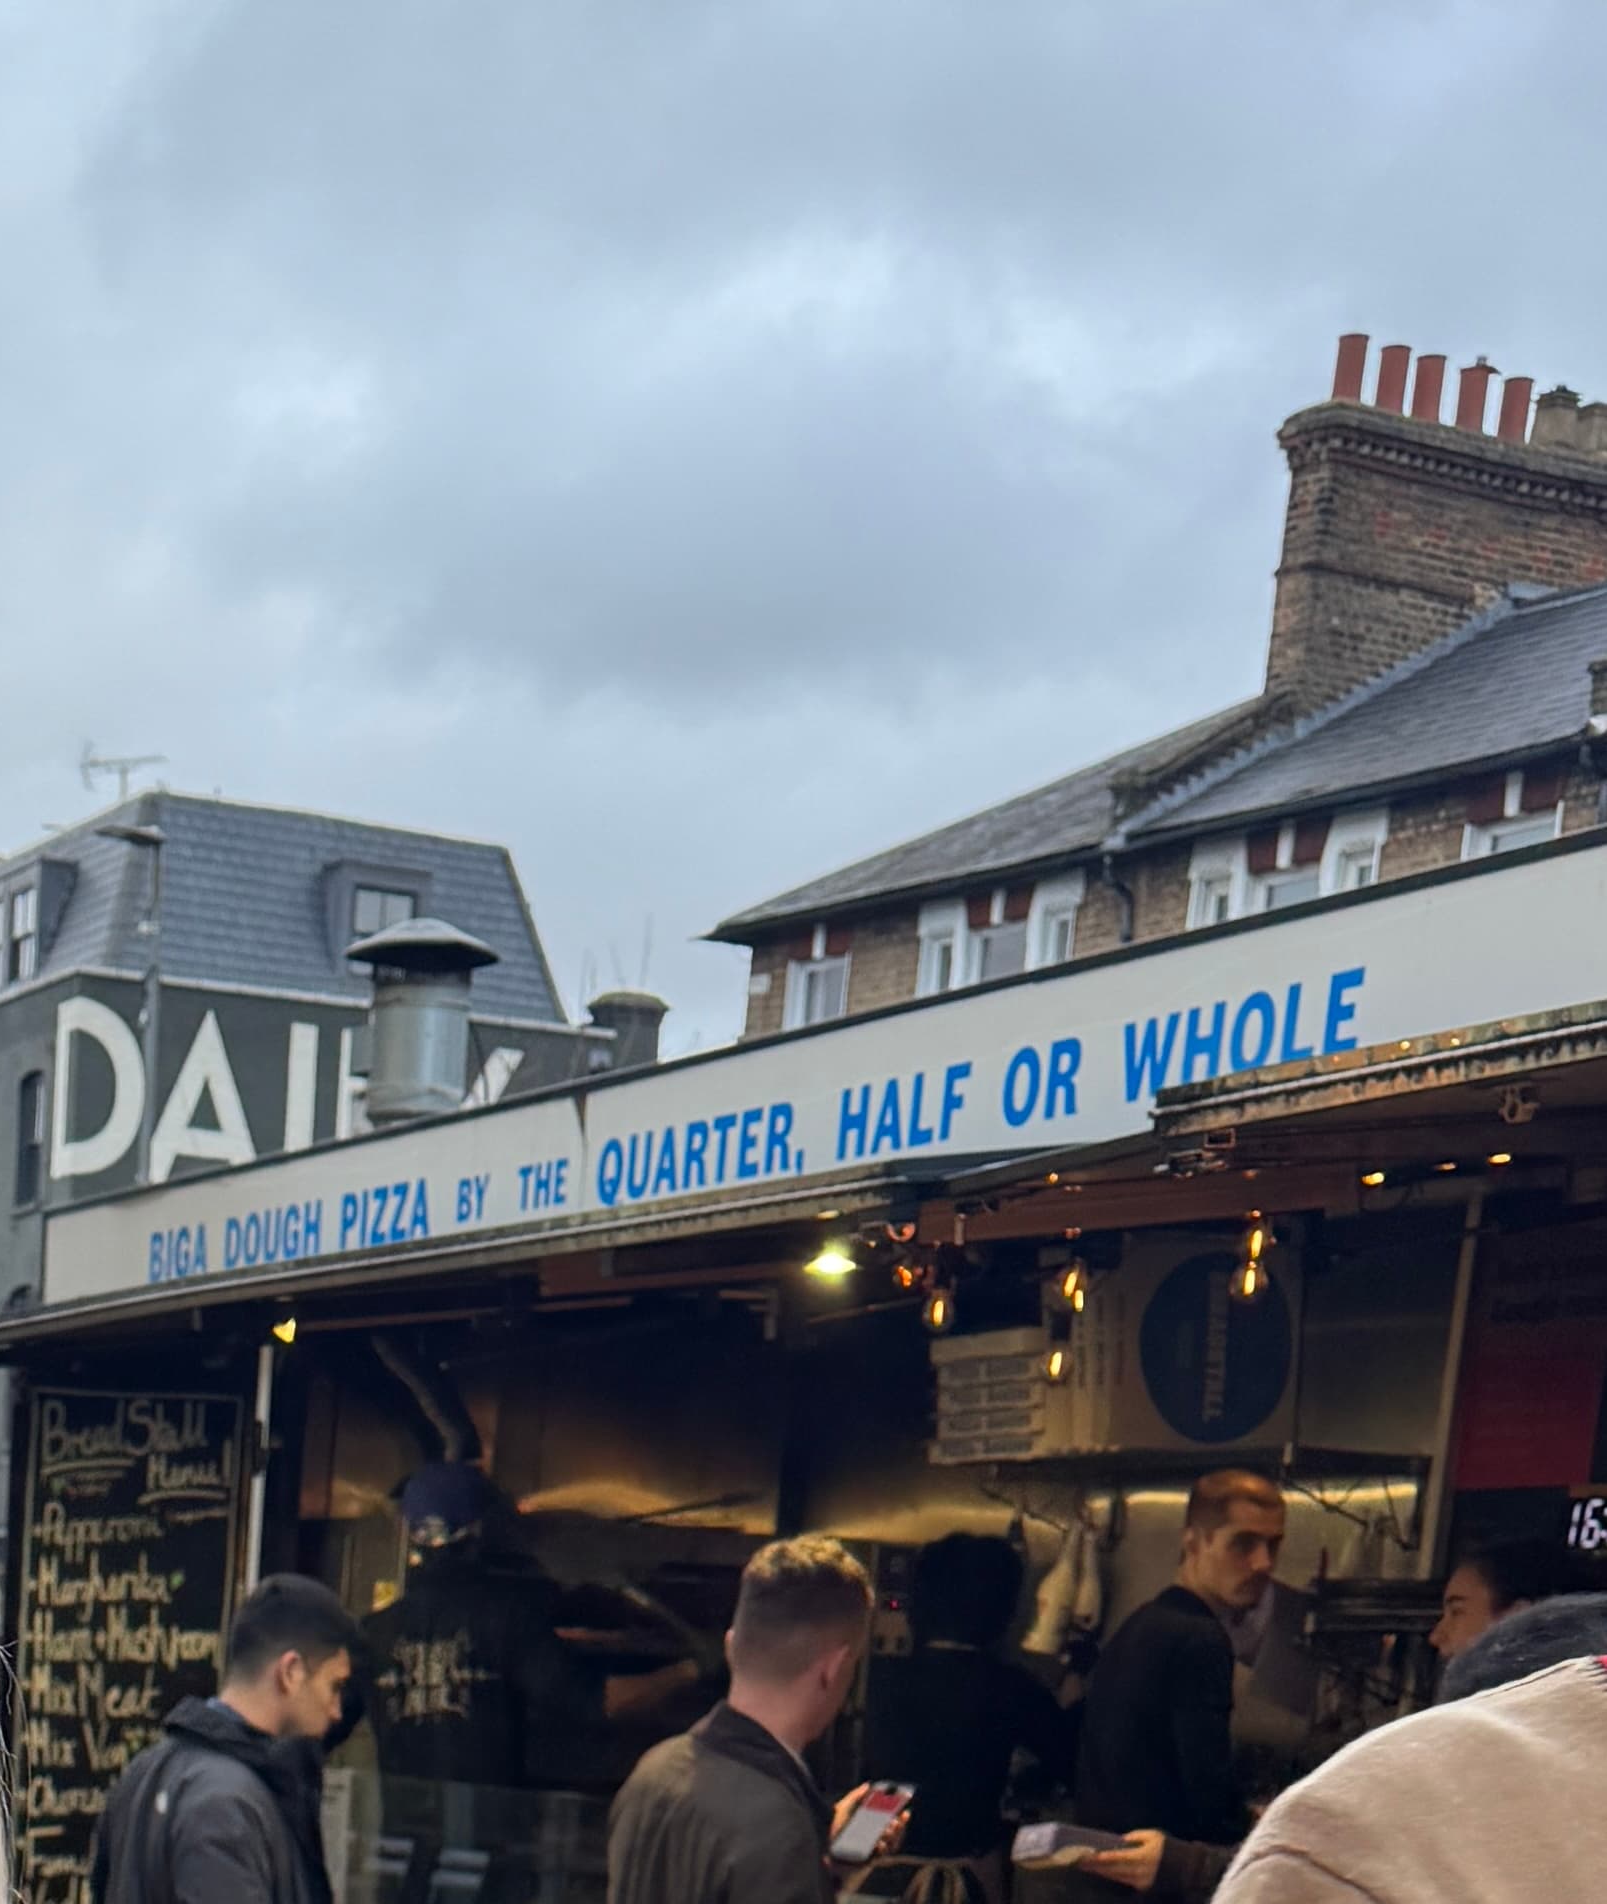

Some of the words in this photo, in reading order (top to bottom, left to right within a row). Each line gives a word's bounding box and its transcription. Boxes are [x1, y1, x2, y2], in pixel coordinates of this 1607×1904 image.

[149, 1222, 207, 1283] BIGA
[225, 1199, 323, 1267] DOUGH
[340, 1177, 429, 1250] PIZZA
[456, 1174, 490, 1223] BY
[519, 1159, 569, 1211] THE
[598, 1102, 804, 1207] QUARTER,
[838, 1062, 971, 1160] HALF
[1004, 1038, 1081, 1127] OR
[1124, 968, 1365, 1102] WHOLE
[128, 1399, 209, 1456] Stall
